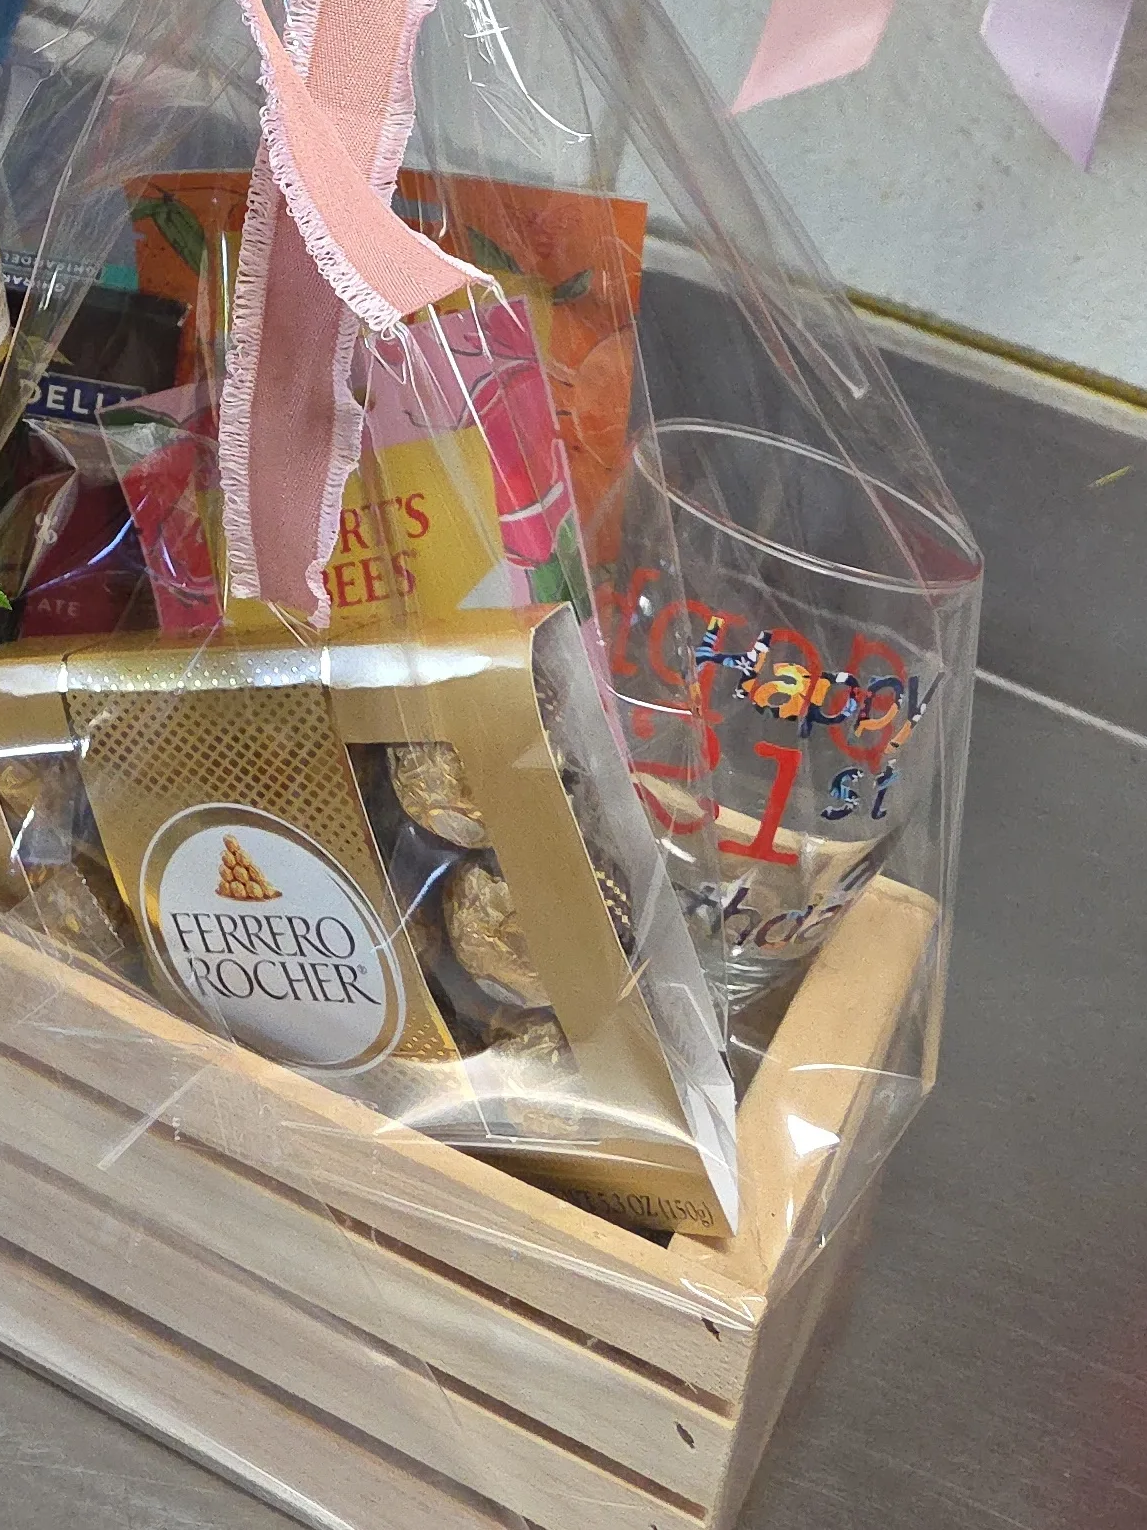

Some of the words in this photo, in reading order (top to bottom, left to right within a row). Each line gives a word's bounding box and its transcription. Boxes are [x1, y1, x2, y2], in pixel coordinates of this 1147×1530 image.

[340, 492, 430, 554] RT'S
[690, 615, 944, 754] Happy
[169, 912, 356, 960] FERRERO
[187, 956, 382, 1005] ROCHER
[657, 1196, 714, 1228] (150g)
